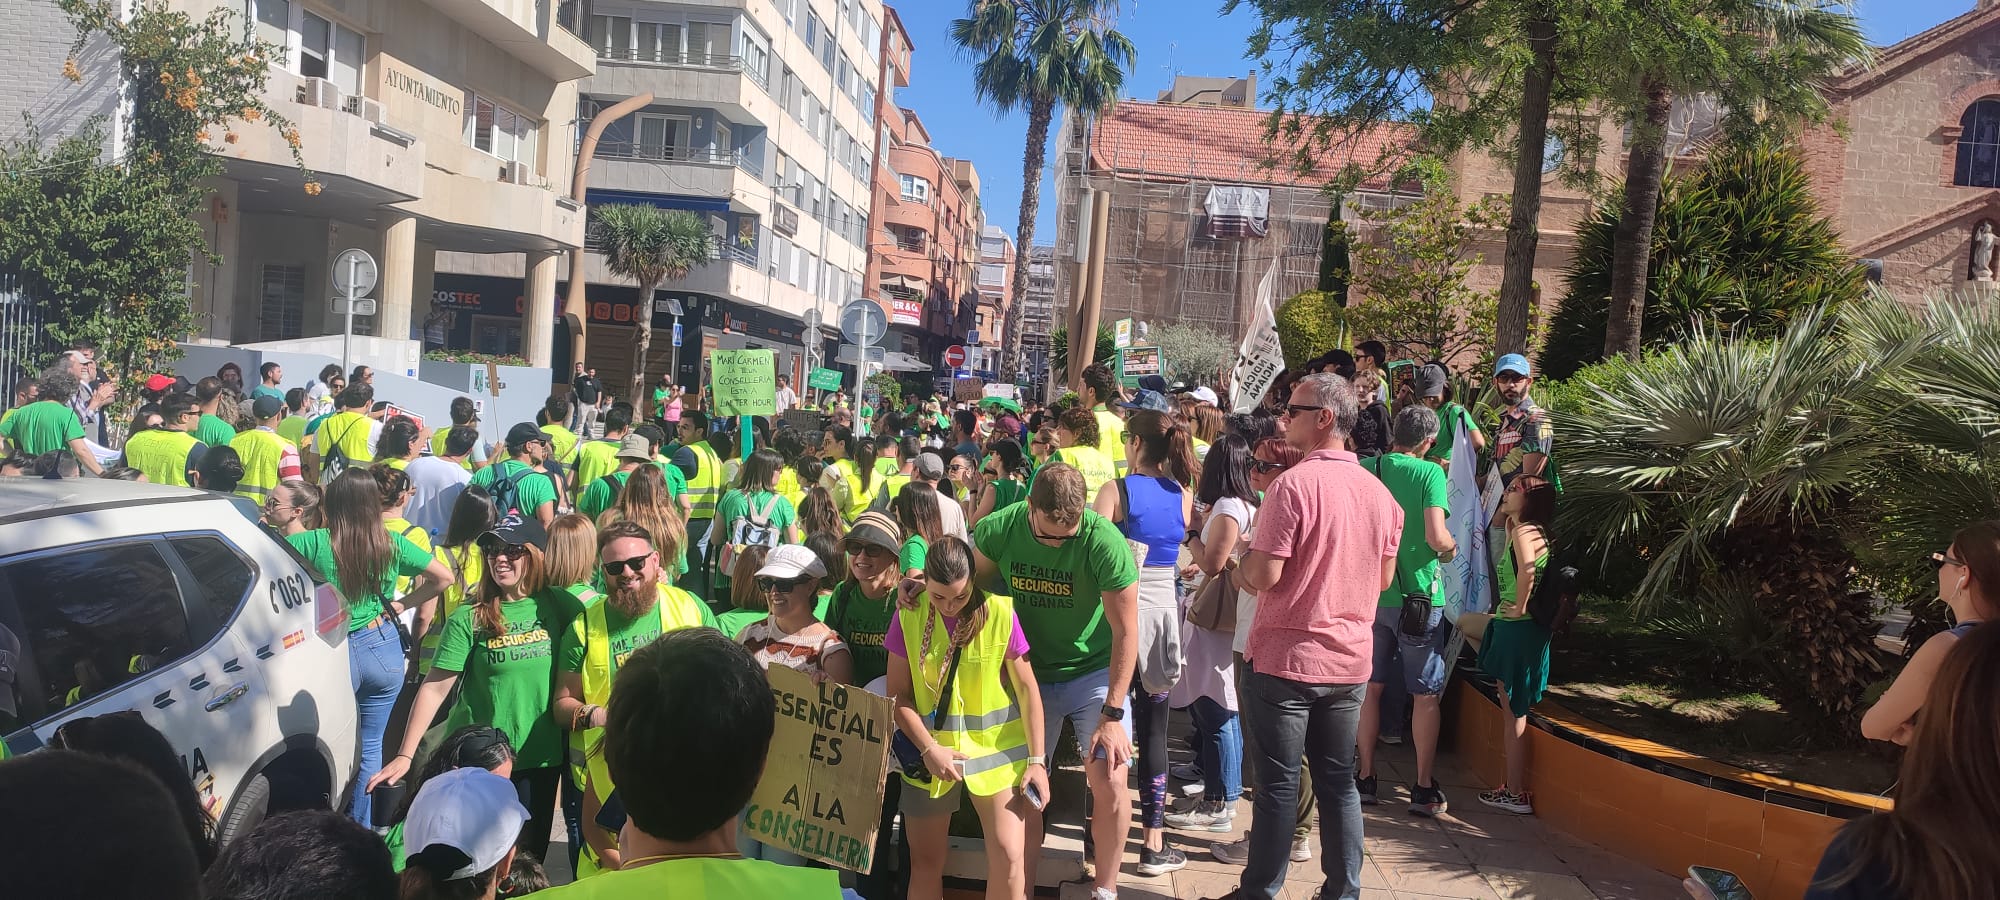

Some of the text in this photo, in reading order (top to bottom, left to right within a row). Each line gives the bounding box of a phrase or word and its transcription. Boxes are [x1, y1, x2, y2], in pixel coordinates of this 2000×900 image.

[385, 67, 460, 115] AYUNTAMIENTO
[737, 355, 770, 366] CARMEN
[752, 398, 772, 407] HOUR
[1011, 561, 1073, 581] ME FALTAN
[277, 572, 312, 610] 062
[1030, 594, 1074, 609] GANAS
[611, 638, 628, 653] ME
[487, 649, 506, 665] NO
[818, 681, 848, 711] LO
[810, 732, 843, 766] ES
[781, 783, 846, 825] A LA
